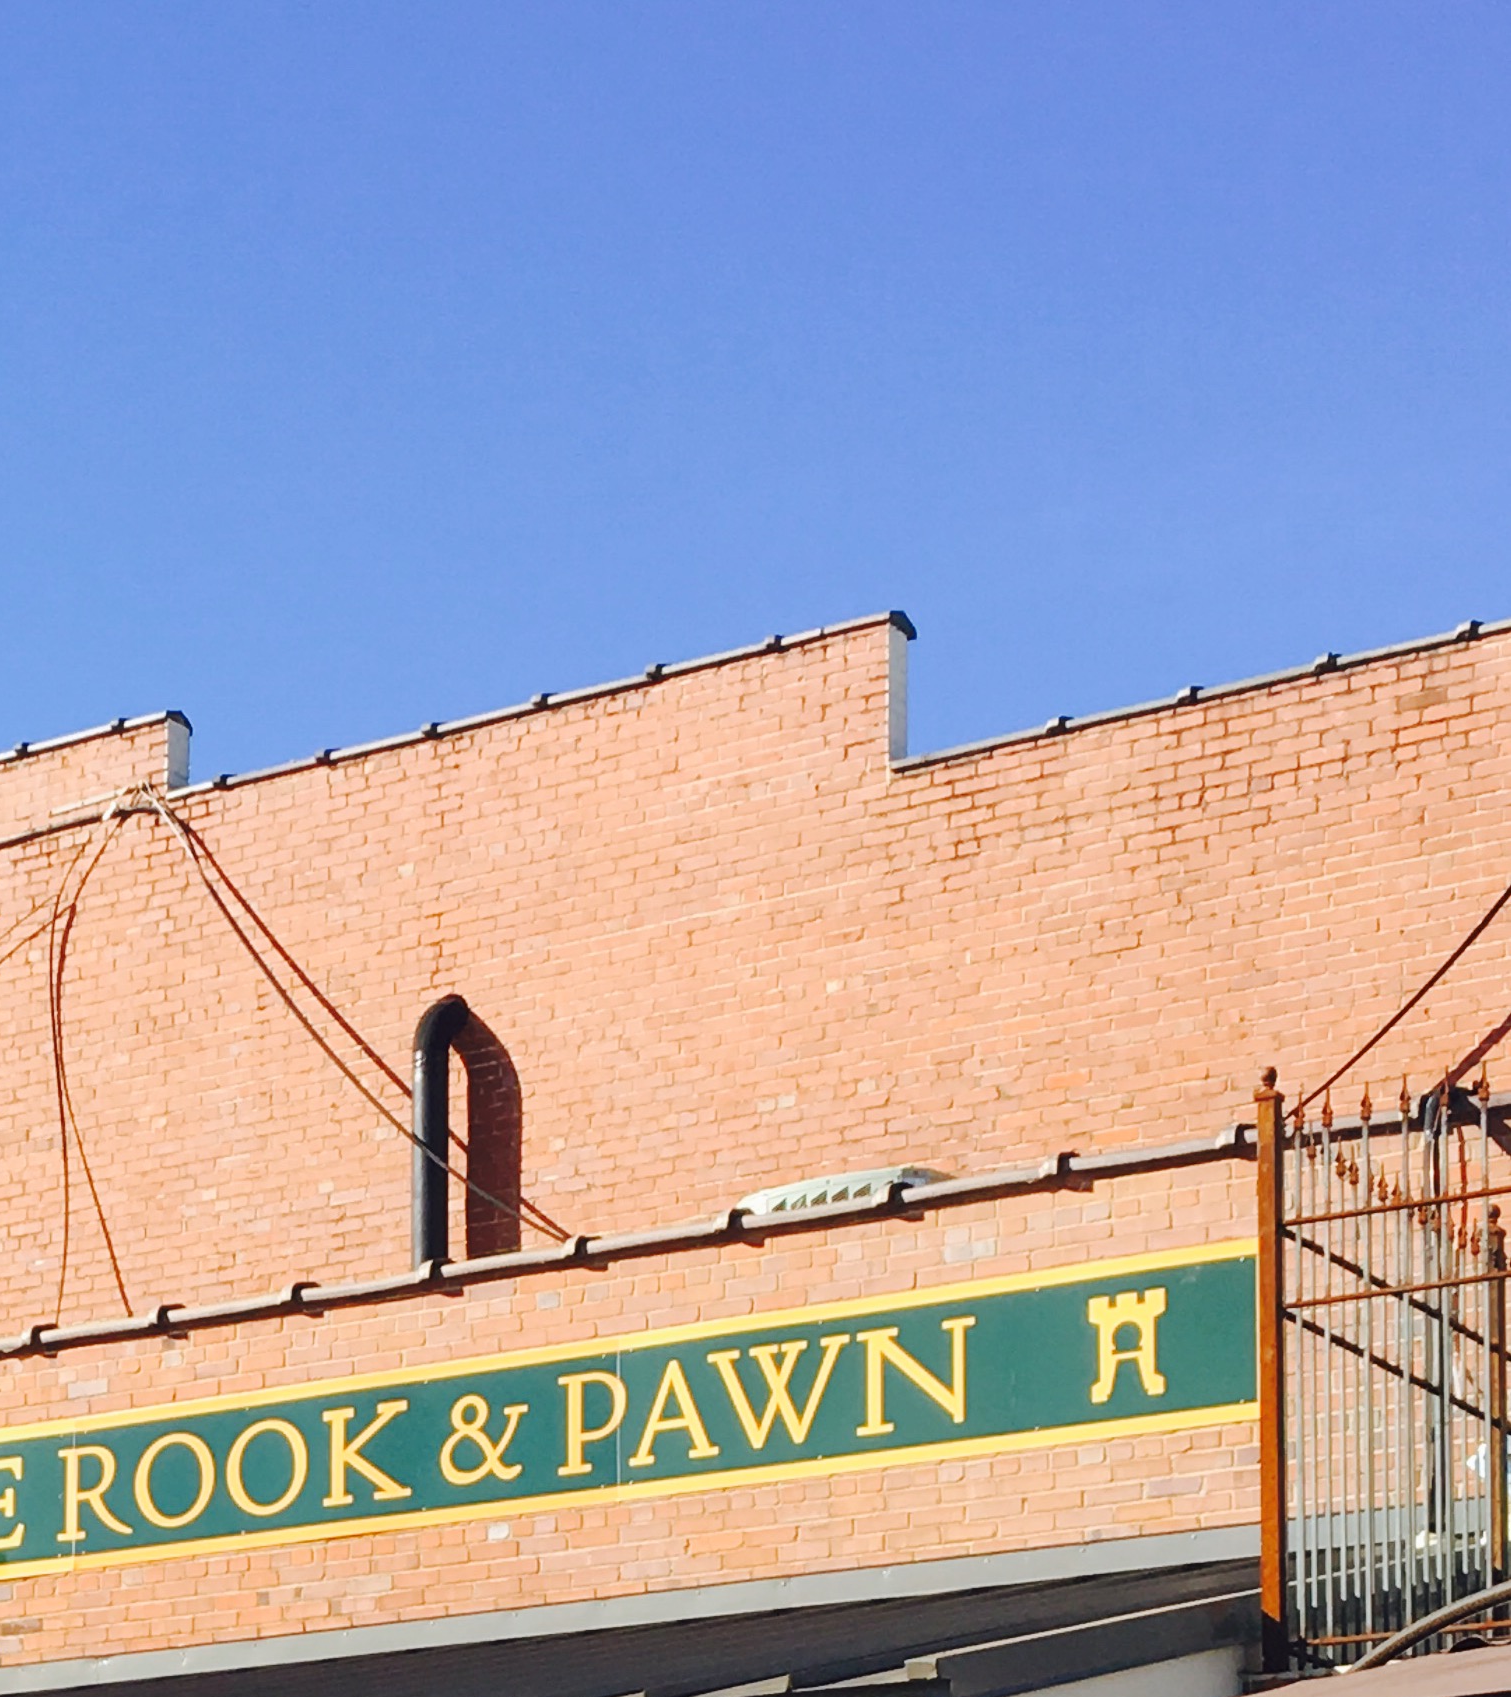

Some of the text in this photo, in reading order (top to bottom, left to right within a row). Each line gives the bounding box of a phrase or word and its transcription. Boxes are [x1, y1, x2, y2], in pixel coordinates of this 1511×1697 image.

[55, 1398, 412, 1542] ROOK
[438, 1394, 529, 1485] &
[556, 1316, 977, 1476] PAWN
